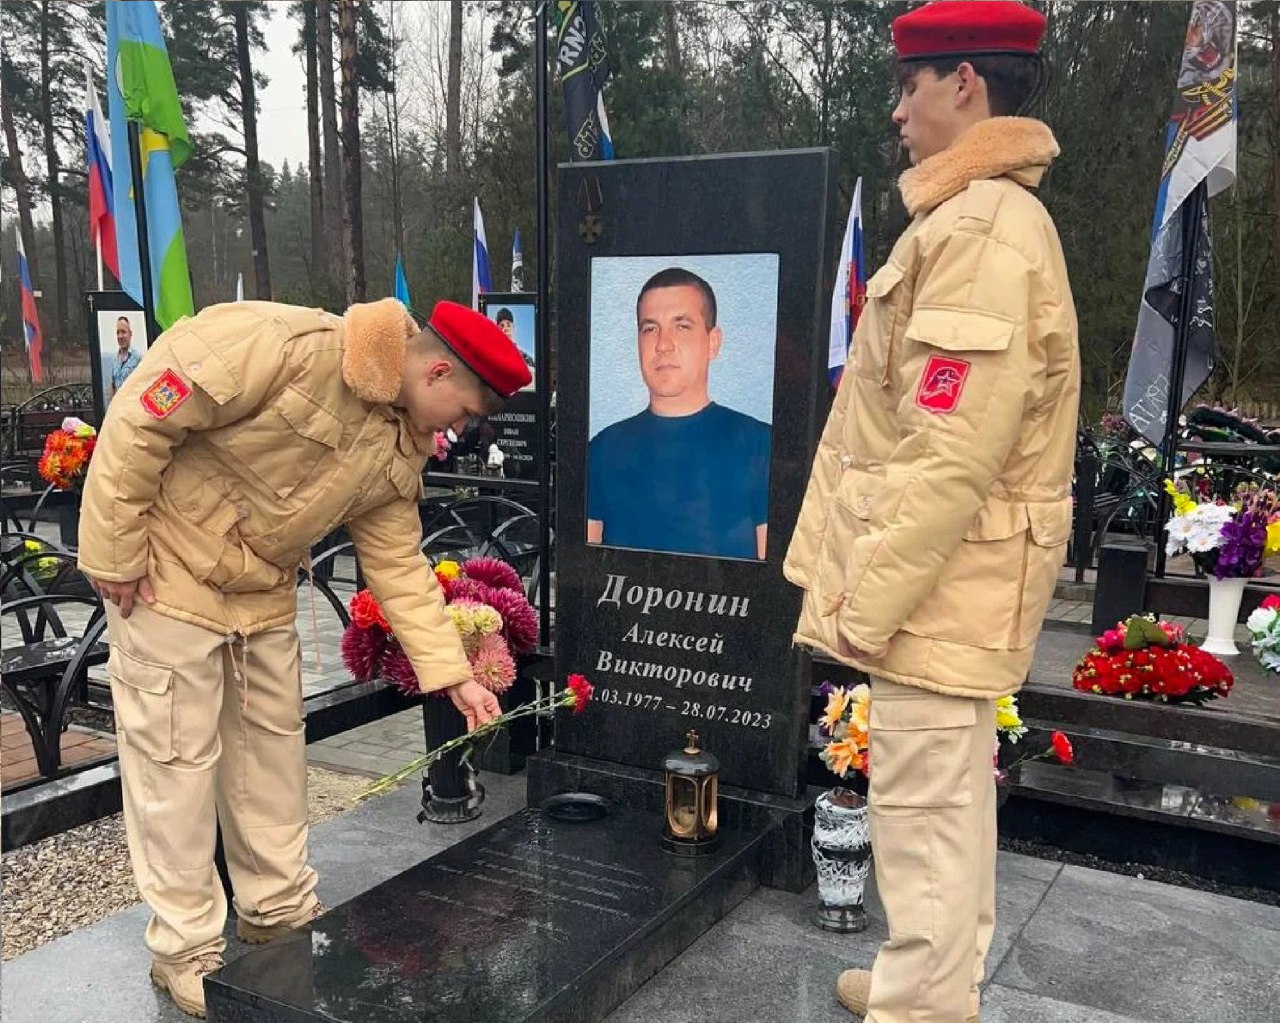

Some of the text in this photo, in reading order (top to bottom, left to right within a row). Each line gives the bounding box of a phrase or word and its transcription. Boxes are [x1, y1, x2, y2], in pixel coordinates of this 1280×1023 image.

[596, 573, 751, 617] Доронин
[621, 621, 724, 655] Алексей
[595, 649, 753, 692] Викторович
[588, 685, 663, 711] 1.03.1977
[681, 700, 773, 730] 28.07.2023
